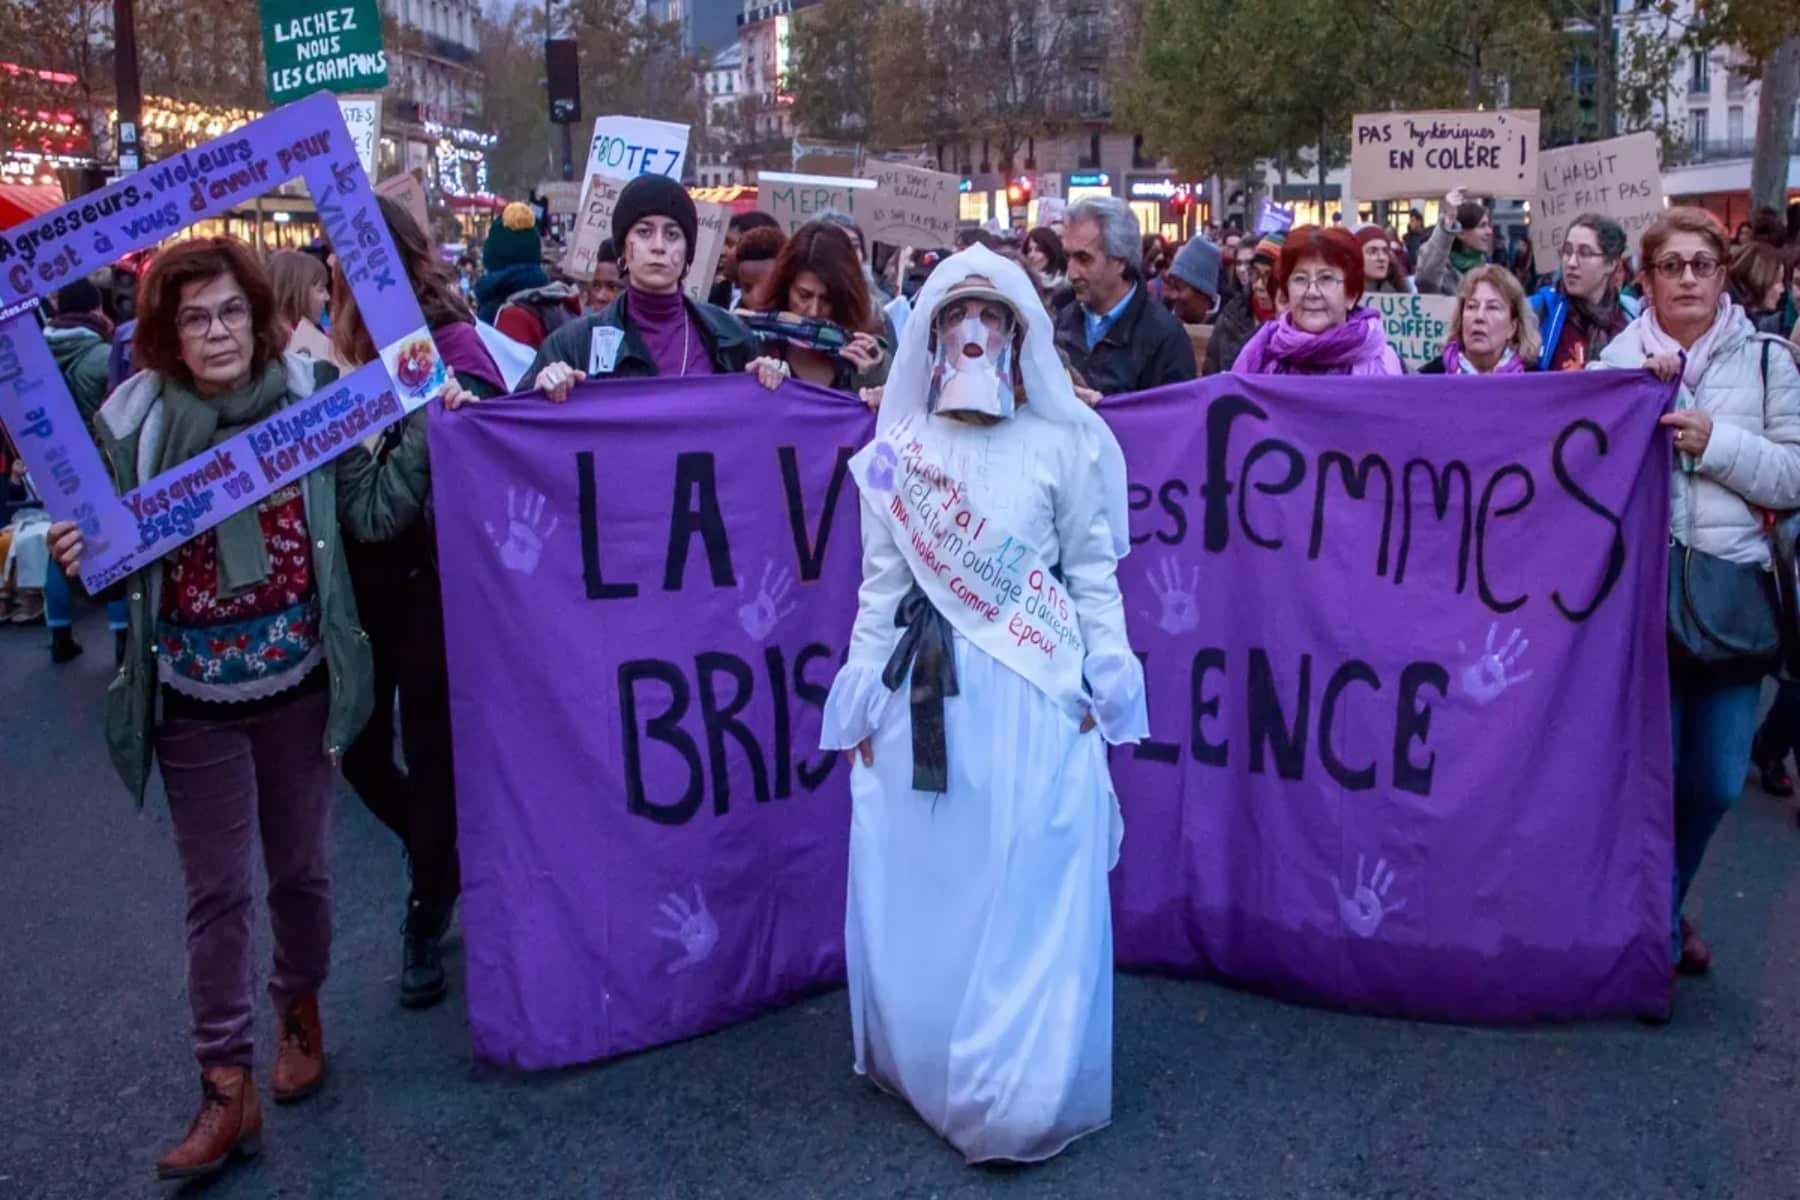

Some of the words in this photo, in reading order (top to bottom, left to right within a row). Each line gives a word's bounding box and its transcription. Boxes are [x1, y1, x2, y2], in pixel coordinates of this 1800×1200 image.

[274, 8, 357, 42] LACHEZ
[297, 36, 341, 61] NOUS
[272, 67, 301, 92] LES
[304, 50, 387, 84] CRAMPONS
[344, 106, 375, 127] STES,
[1358, 124, 1392, 145] PAS
[150, 138, 253, 192] violeurs
[1389, 149, 1414, 169] EN
[1425, 140, 1501, 170] COLÈRE
[9, 244, 82, 294] C'est
[93, 230, 115, 254] à
[120, 201, 181, 240] vous
[189, 158, 268, 211] d'avoir
[277, 129, 331, 174] peur
[1541, 193, 1568, 218] NE
[1575, 187, 1611, 208] FAIT
[1619, 179, 1651, 201] PAS
[318, 184, 369, 288] VIVRE
[352, 207, 396, 292] veux
[0, 296, 40, 320] utes.org
[222, 470, 255, 500] ve
[575, 450, 738, 599] LA
[1128, 478, 1189, 546] es
[1202, 394, 1627, 622] femmes
[949, 576, 1001, 623] comme
[997, 535, 1027, 573] 12
[1028, 568, 1069, 622] ans
[616, 642, 849, 827] BRIS
